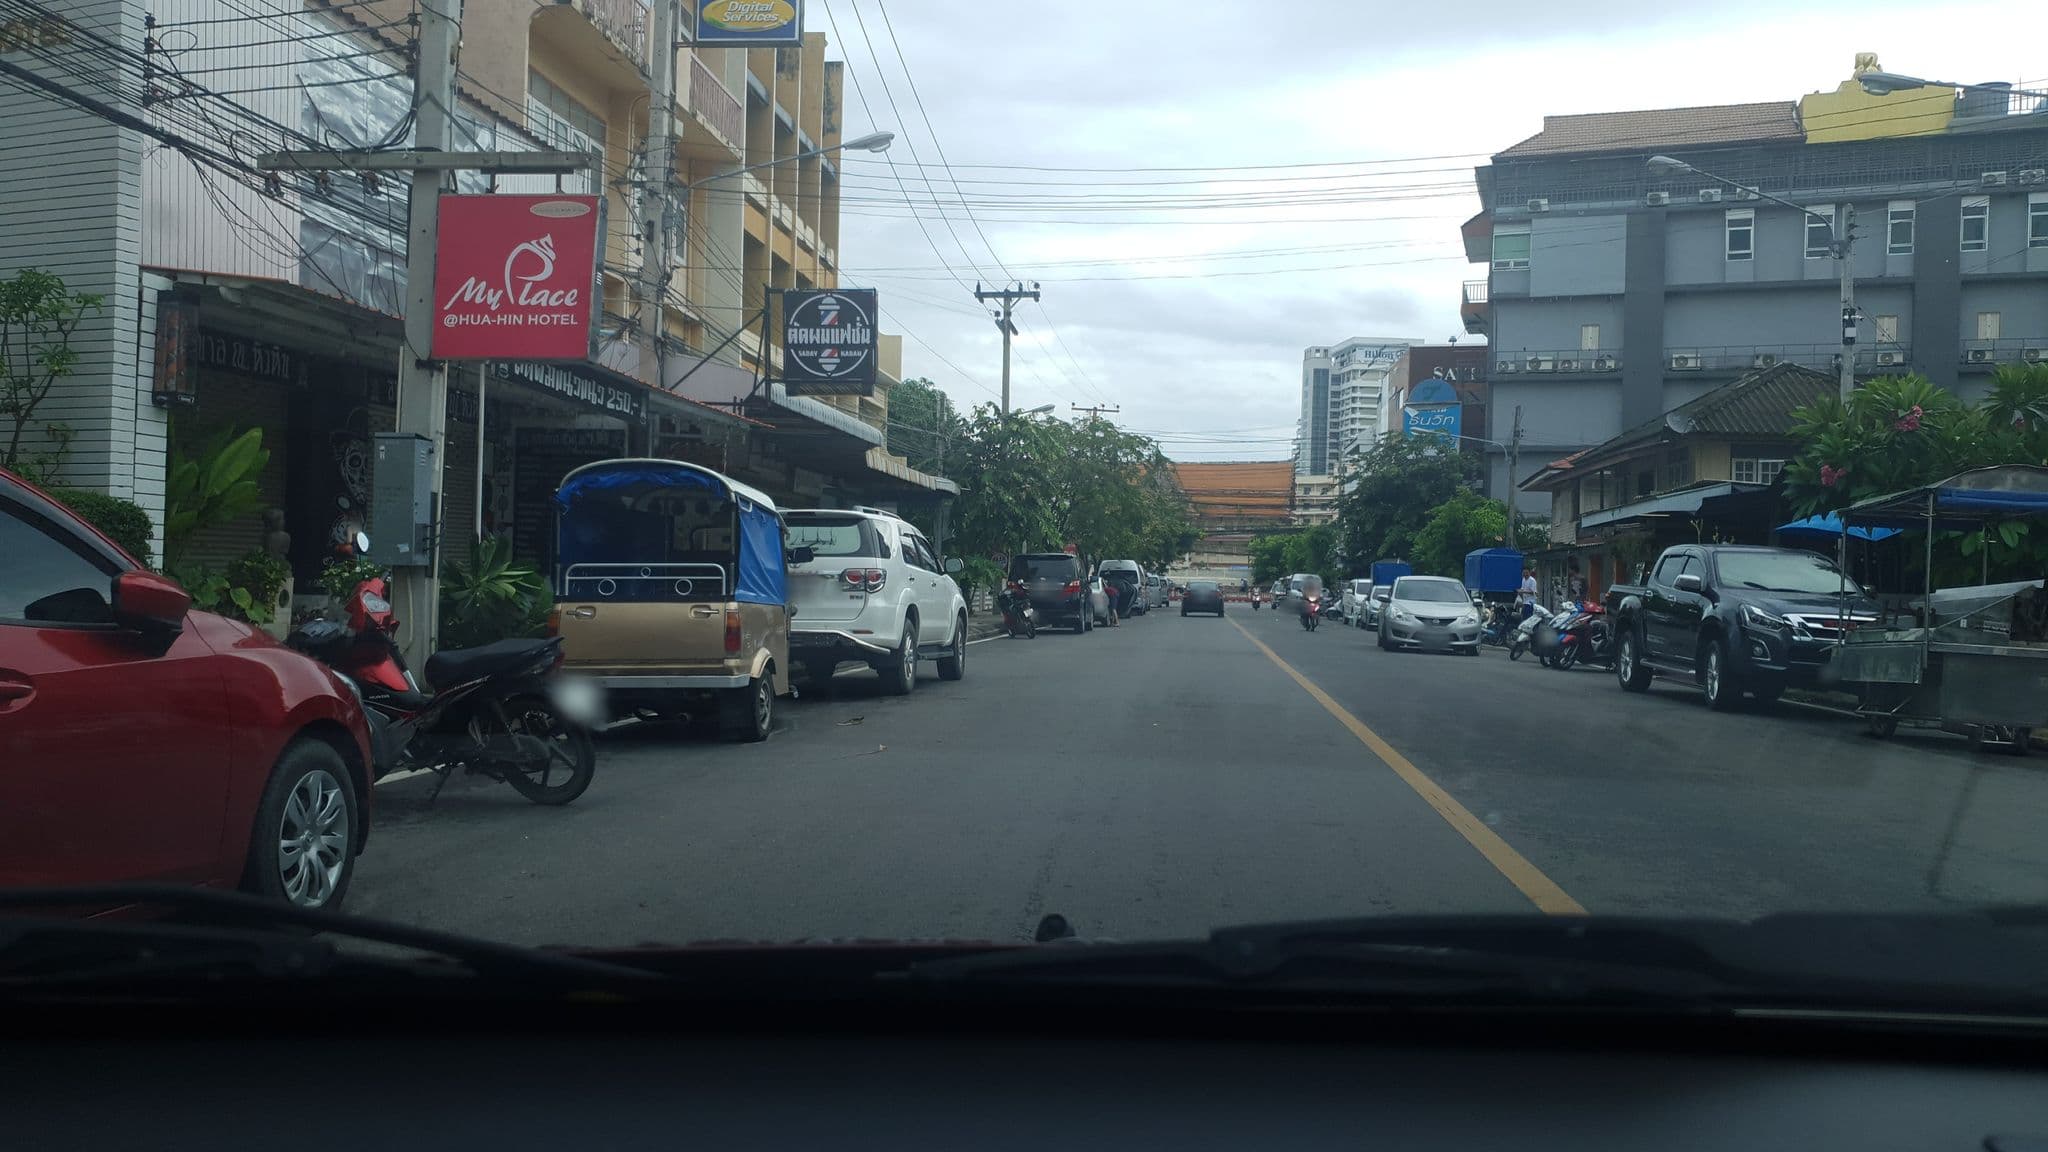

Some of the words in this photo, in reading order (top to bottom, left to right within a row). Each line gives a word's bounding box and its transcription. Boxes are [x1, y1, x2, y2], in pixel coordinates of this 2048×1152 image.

[727, 1, 774, 14] Digital
[723, 12, 779, 22] Services
[443, 276, 503, 311] My
[504, 233, 578, 308] Place
[443, 314, 523, 328] @HUA-HIN
[528, 314, 578, 326] HOTEL
[787, 316, 871, 345] ตัดผมแฟชั่น
